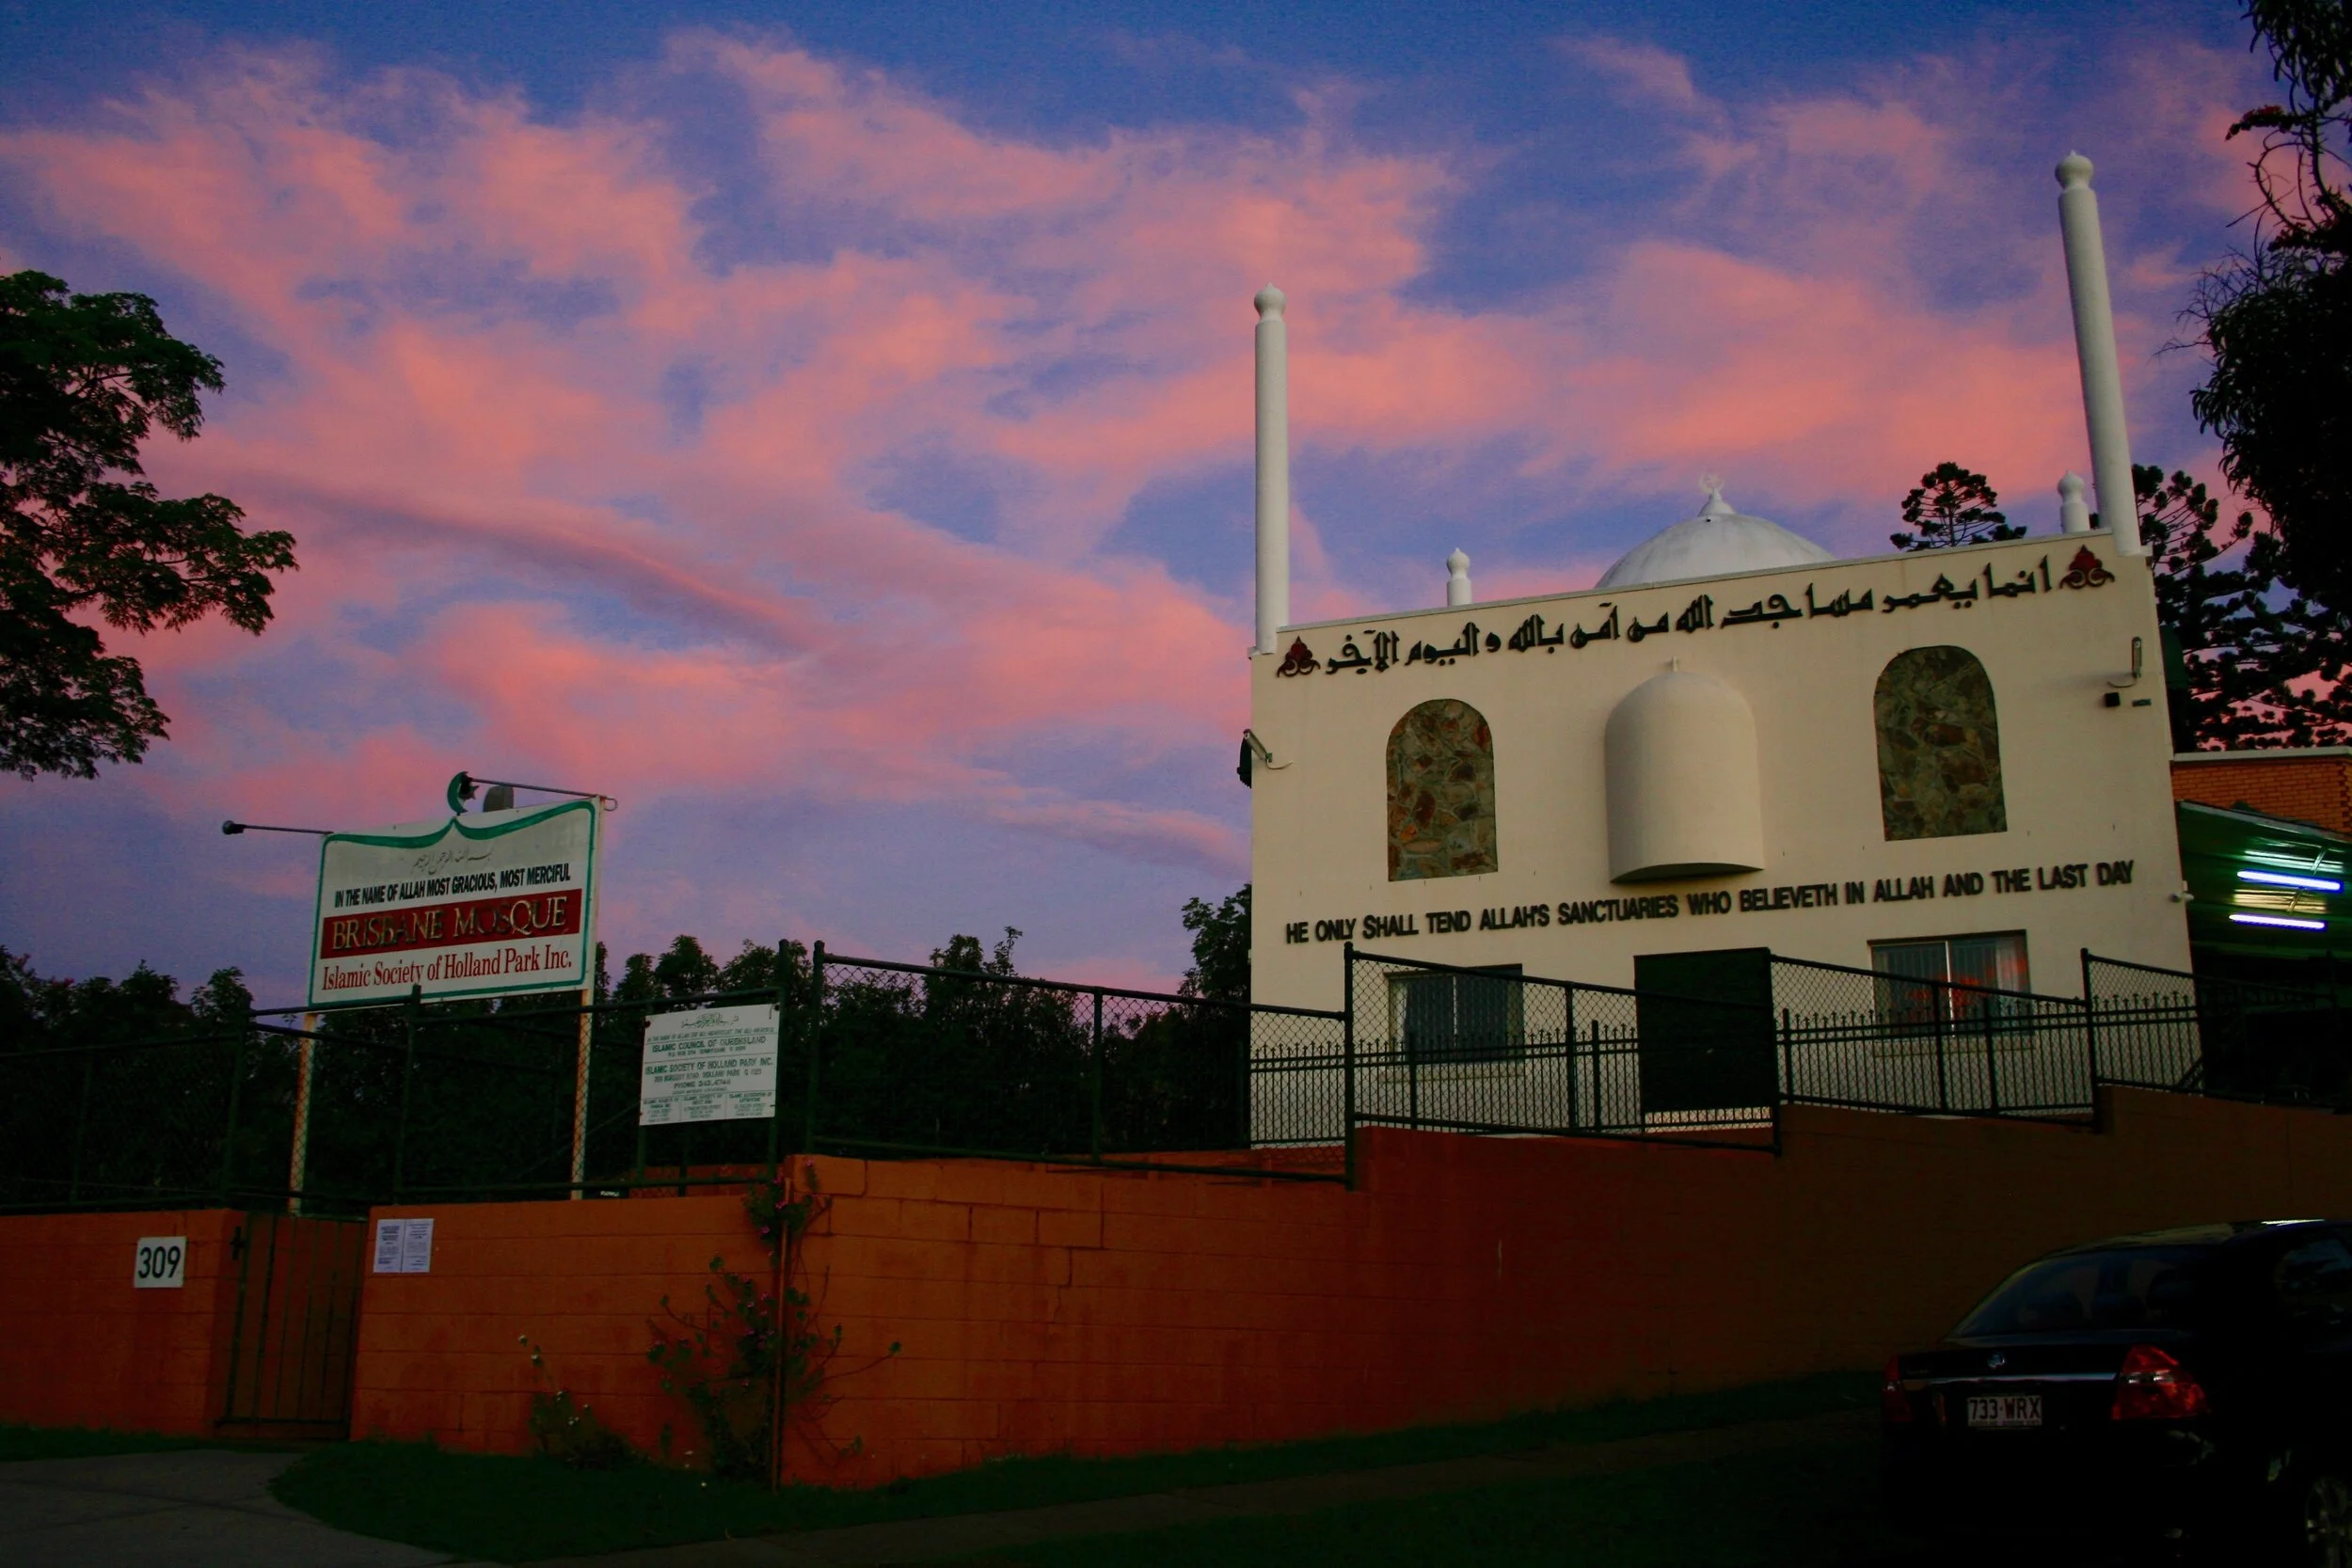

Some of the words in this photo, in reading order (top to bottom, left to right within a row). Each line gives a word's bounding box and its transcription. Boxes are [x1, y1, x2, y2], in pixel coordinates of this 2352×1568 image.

[1720, 581, 1873, 629] مساجد
[1882, 573, 1979, 613] يعمر
[1508, 613, 1565, 654] بالله
[1627, 611, 1669, 642] من
[1676, 594, 1714, 633] الله
[334, 890, 344, 908] IN
[345, 888, 360, 907] THE
[361, 885, 387, 905] NAME
[387, 883, 399, 902] OF
[399, 879, 426, 901] ALLAH
[426, 877, 451, 897] MOST
[452, 871, 498, 895] GRACIOUS,
[500, 868, 525, 889] MOST
[527, 863, 571, 885] MERCIFUL
[1285, 922, 1309, 943] HE
[1316, 918, 1356, 941] ONLY
[1362, 913, 1419, 940] SHALL
[1425, 910, 1471, 934] TEND
[1479, 903, 1550, 931] ALLAH'S
[1558, 894, 1678, 926] SANCTUARIES
[1686, 890, 1731, 917] WHO
[1740, 882, 1838, 913] BELIEVETH
[1845, 880, 1866, 905] IN
[1873, 876, 1934, 903] ALLAH
[1942, 872, 1984, 898] AND
[1991, 868, 2031, 895] THE
[2037, 863, 2089, 890] LAST
[2096, 860, 2135, 886] DAY
[332, 908, 444, 950] BRISBANE
[453, 895, 568, 938] MOSQUE
[323, 962, 371, 990] Islamic
[373, 958, 424, 987] Society
[427, 955, 443, 980] of
[444, 948, 501, 979] Holland
[504, 945, 540, 974] Park
[544, 943, 573, 969] Inc.
[652, 1041, 675, 1053] ISLAMIC
[678, 1038, 706, 1051] COUNCIL
[707, 1038, 718, 1048] OF
[720, 1036, 767, 1047] QUEENSLAND
[645, 1064, 668, 1075] ISLAMIC
[669, 1061, 694, 1073] SOCIETY
[697, 1061, 706, 1070] OF
[707, 1058, 738, 1070] HOLLAND
[739, 1057, 757, 1068] PARK
[674, 1081, 696, 1089] PHONE
[137, 1245, 181, 1278] 309
